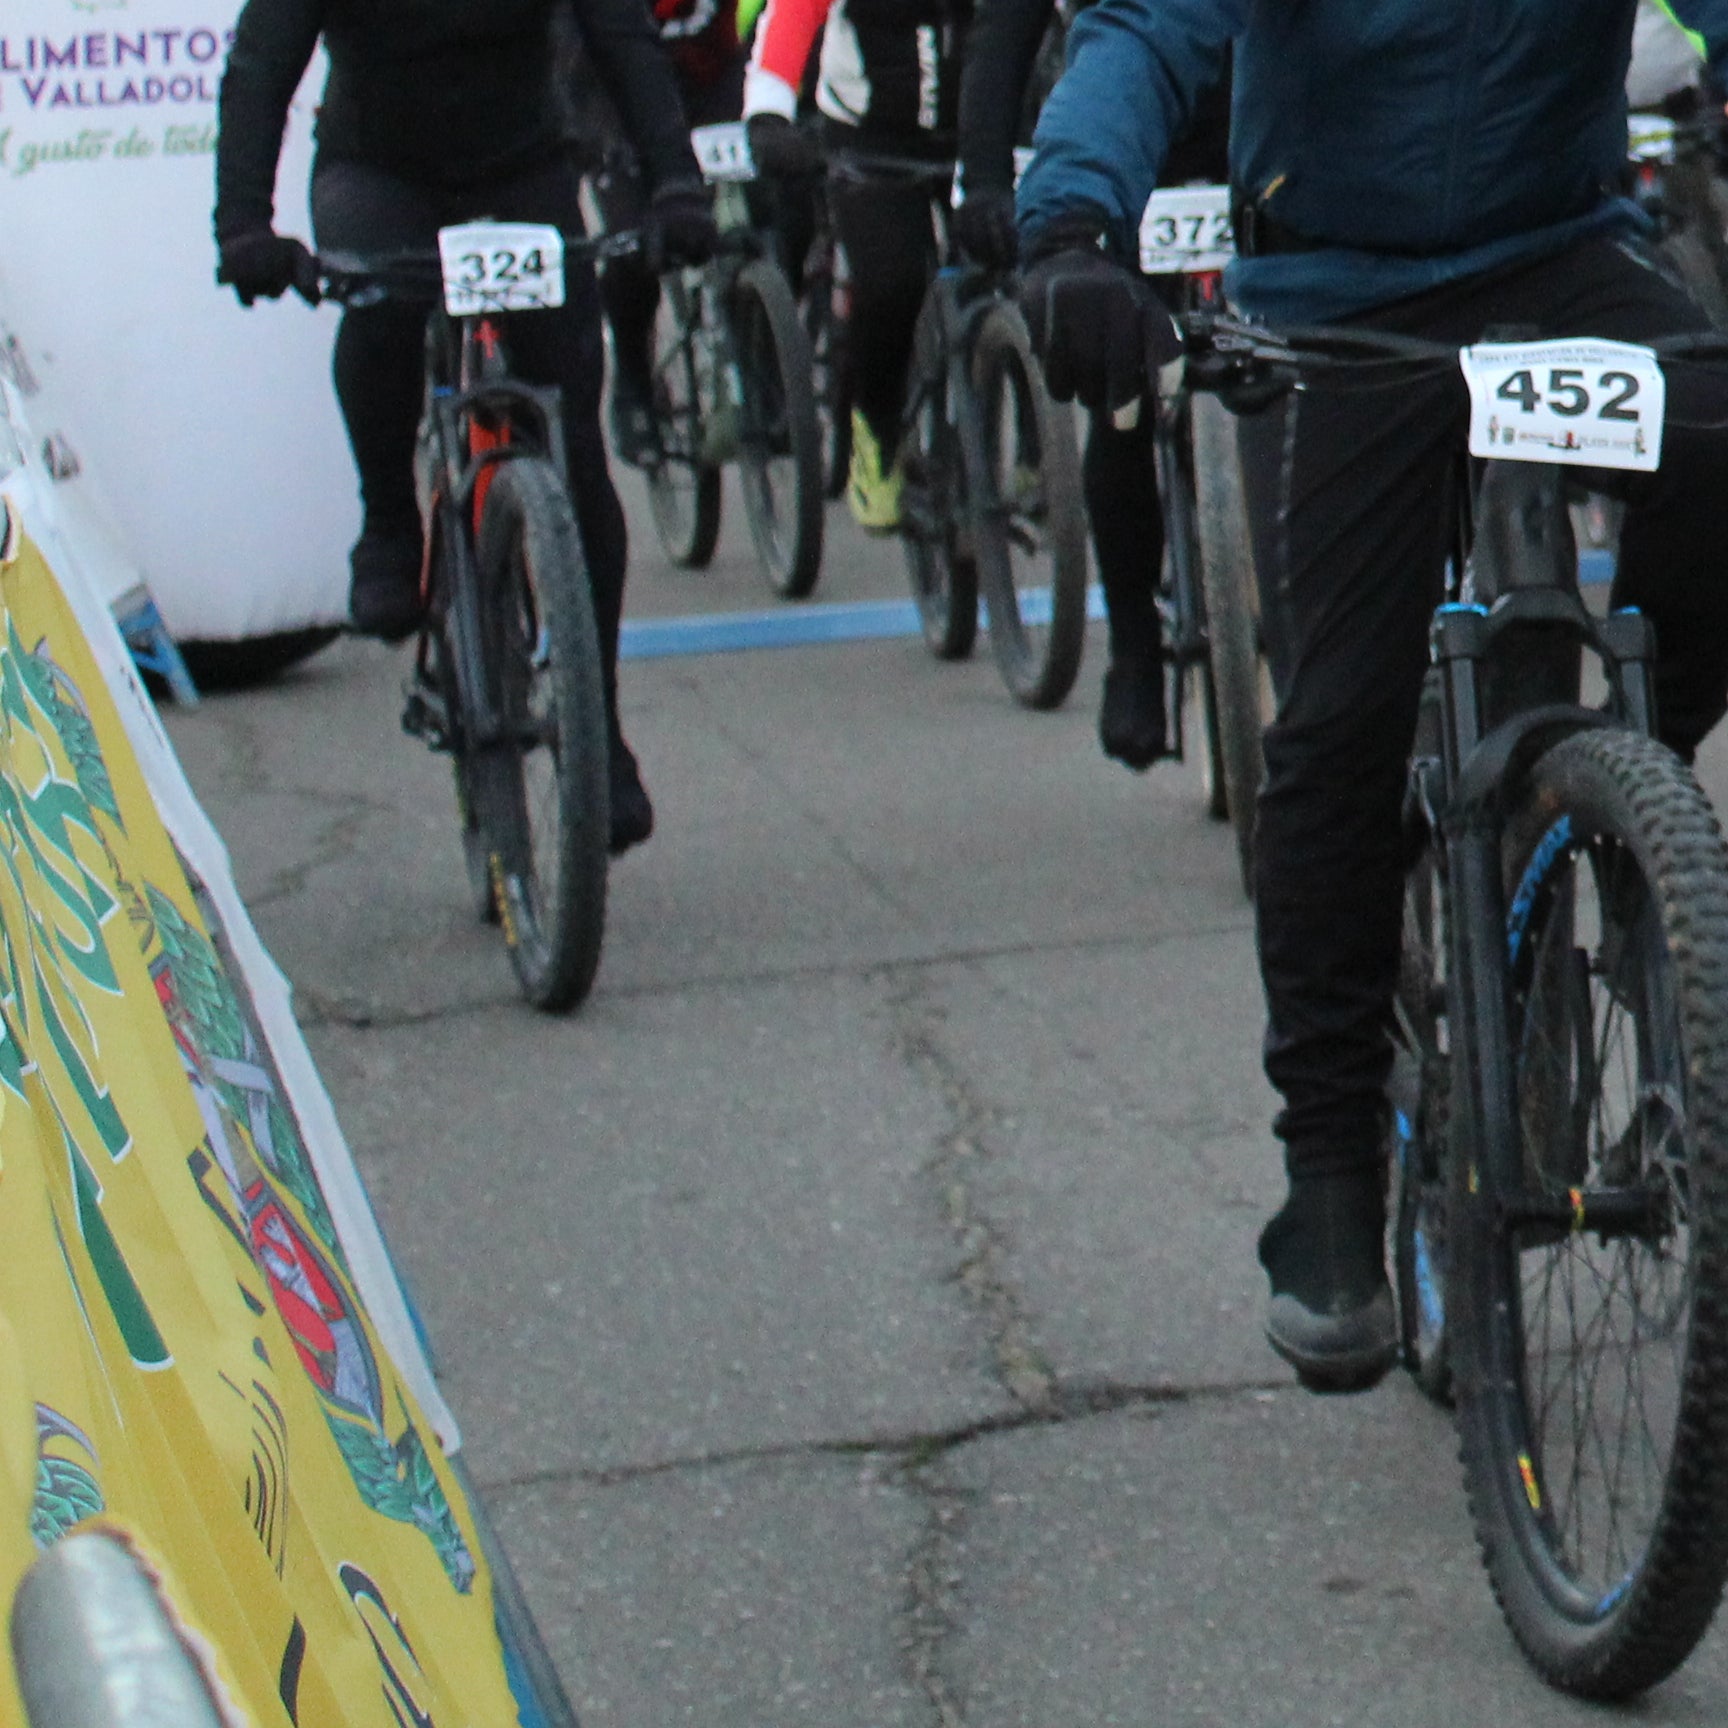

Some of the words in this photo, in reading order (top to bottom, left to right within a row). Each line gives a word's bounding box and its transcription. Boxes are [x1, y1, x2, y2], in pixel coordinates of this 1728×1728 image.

[0, 28, 237, 71] LIMENTO
[1153, 214, 1236, 246] 372
[459, 248, 546, 286] 324
[1496, 369, 1640, 423] 452
